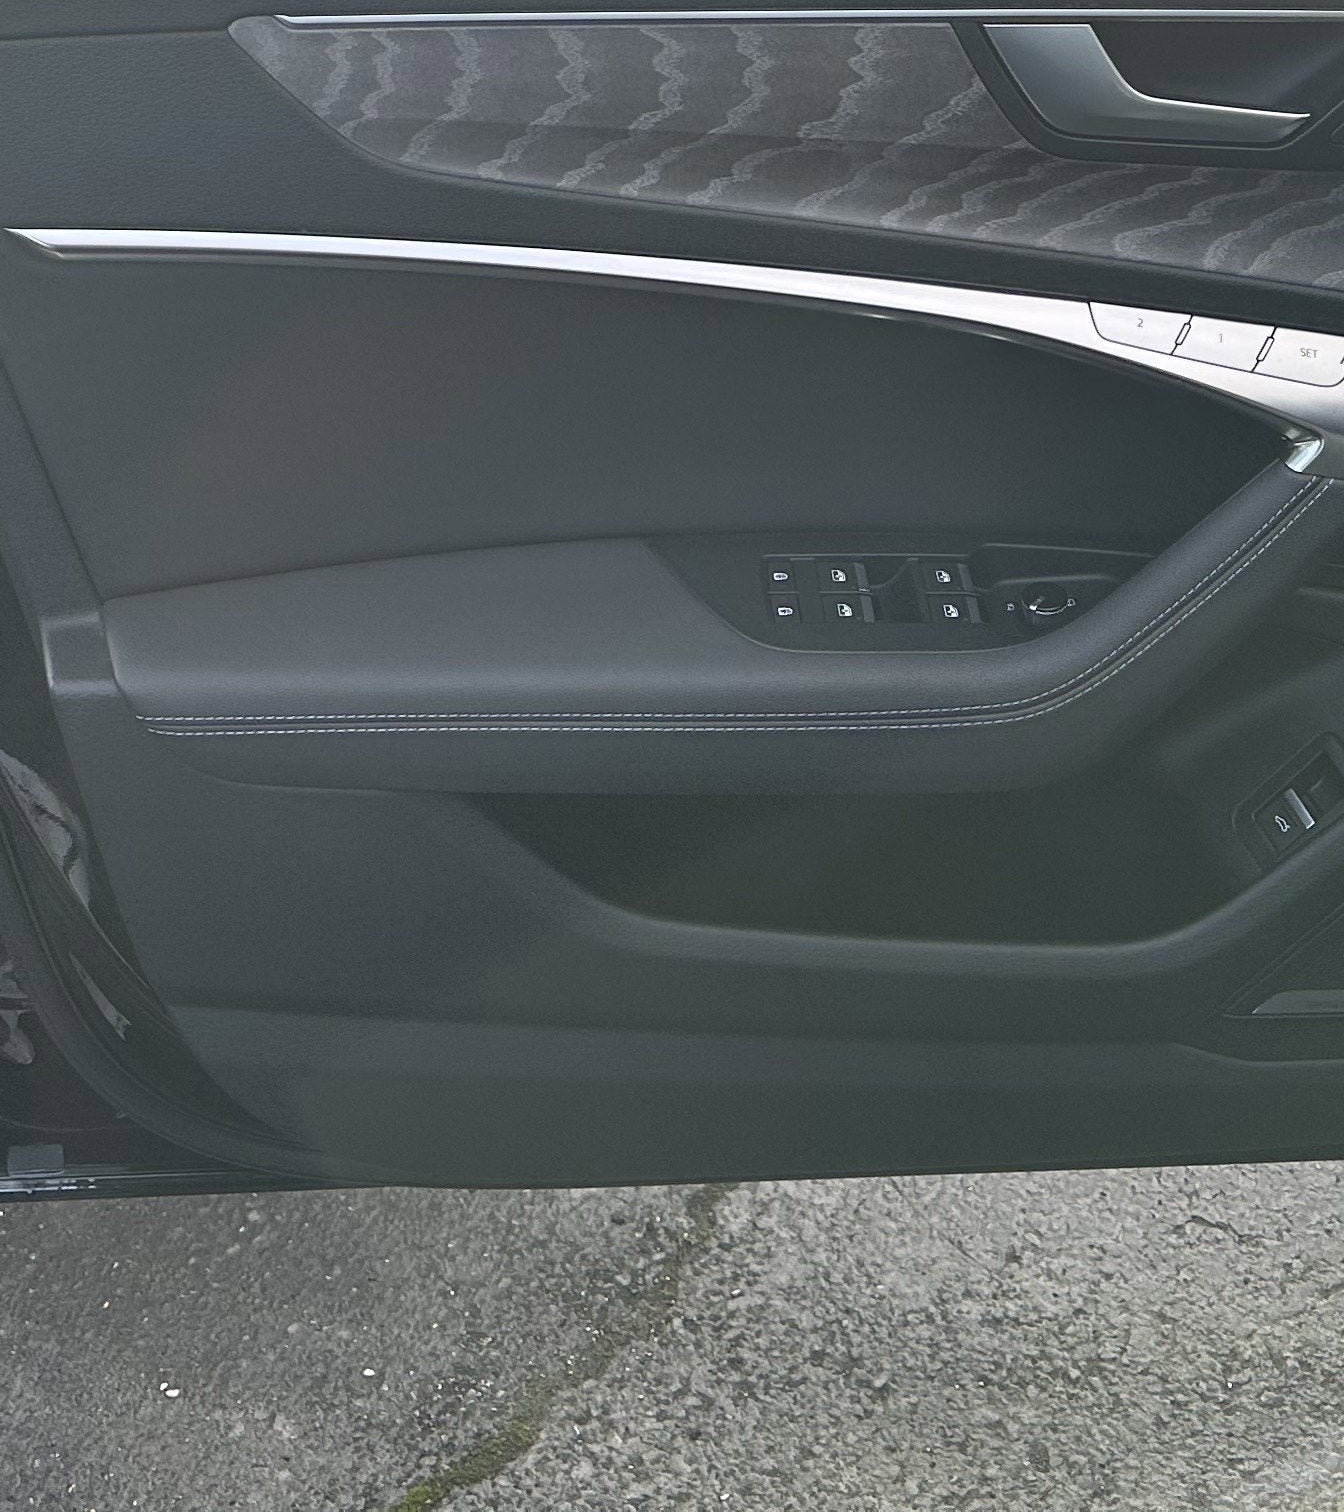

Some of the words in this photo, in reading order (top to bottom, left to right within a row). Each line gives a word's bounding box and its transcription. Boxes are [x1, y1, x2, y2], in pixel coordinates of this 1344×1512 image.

[1137, 317, 1145, 328] 2
[1218, 333, 1224, 344] 1
[1299, 347, 1319, 359] SET
